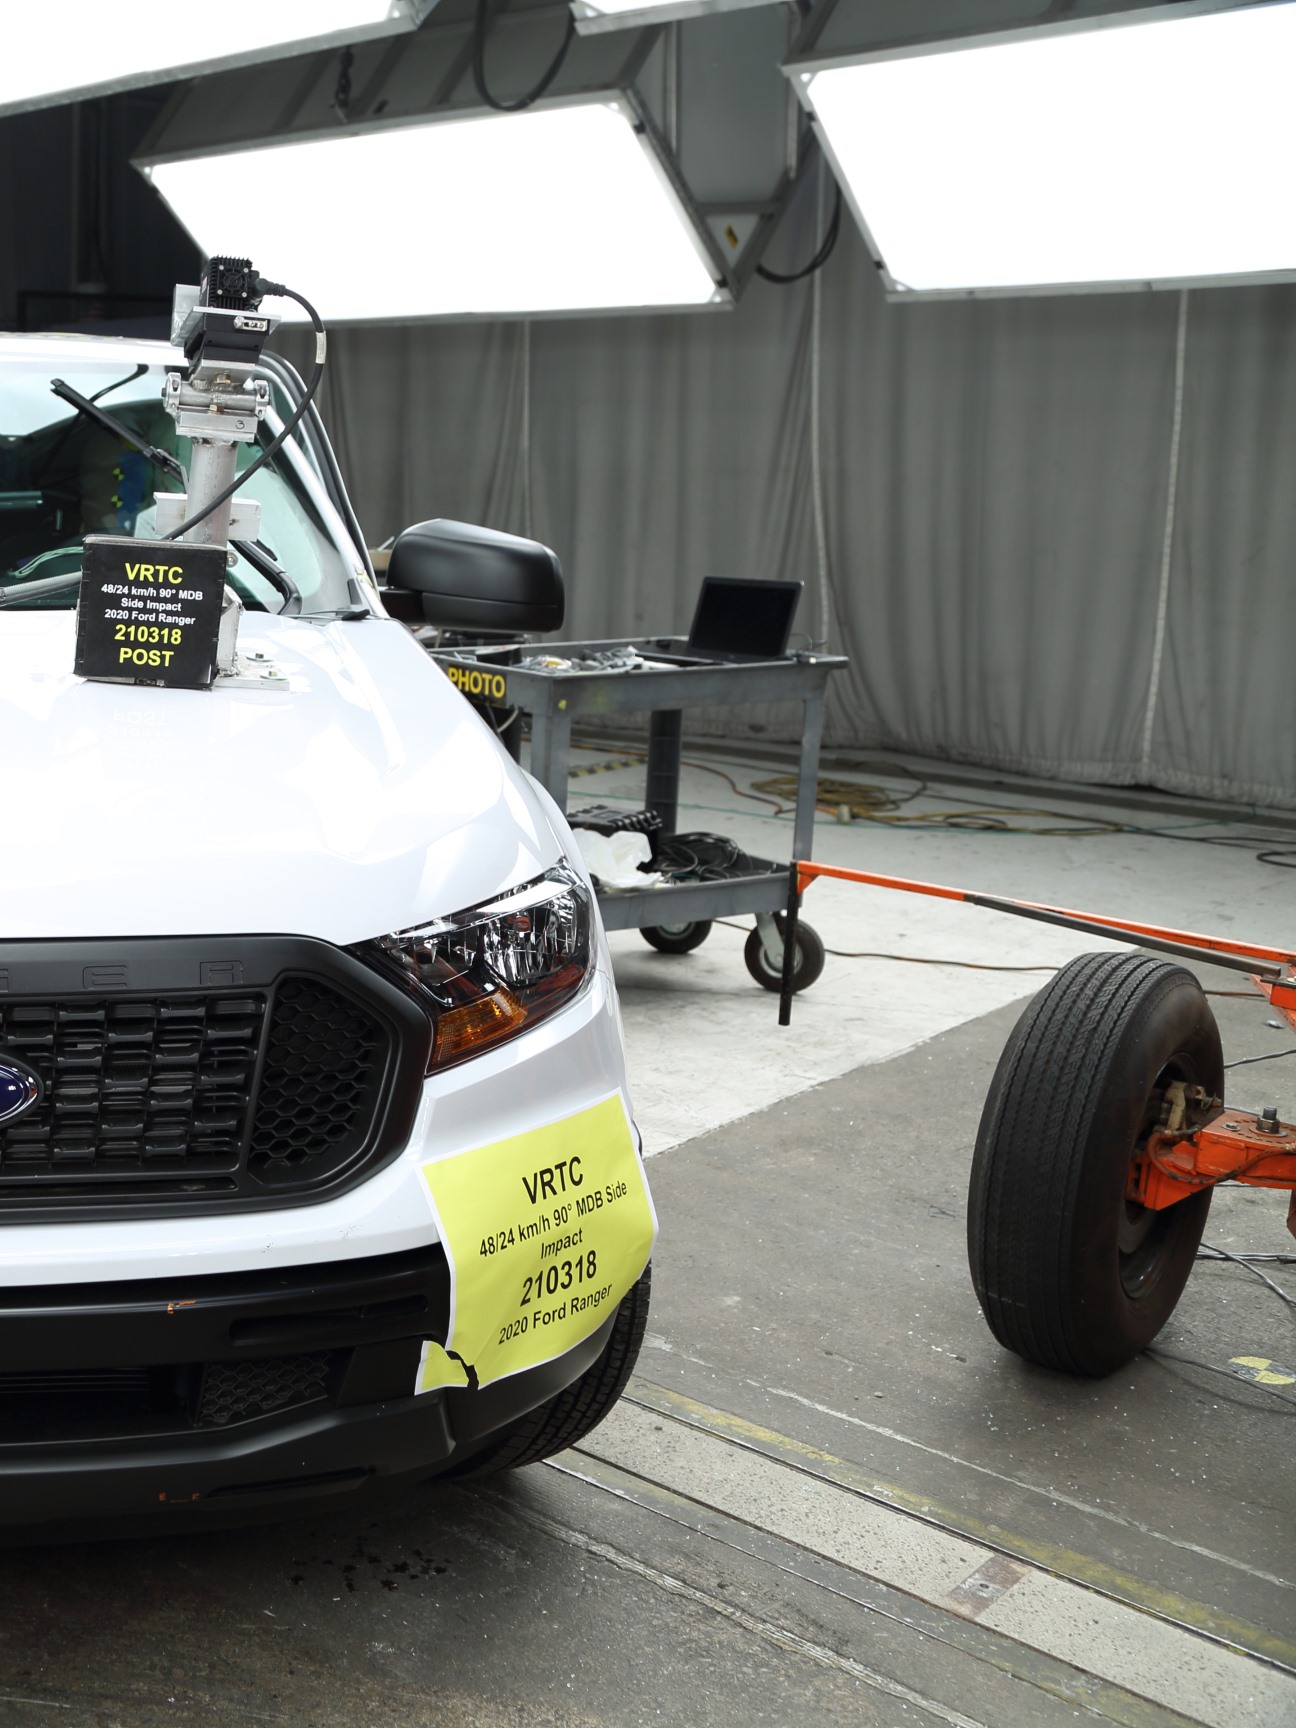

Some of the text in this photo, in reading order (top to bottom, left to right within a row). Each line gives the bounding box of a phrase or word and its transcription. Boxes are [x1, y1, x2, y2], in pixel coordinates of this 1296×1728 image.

[235, 419, 245, 430] 3
[125, 563, 183, 584] VRTC
[101, 584, 203, 600] 48/24 km/h 90° MDB
[121, 598, 182, 612] Side Impact
[104, 609, 196, 626] 2020 Ford Ranger
[114, 624, 182, 645] 210318
[118, 648, 174, 667] POST
[448, 667, 506, 698] PHOTO
[522, 1156, 584, 1205] VRTC
[479, 1180, 628, 1258] 48/24 km/h 90° MDB Side
[540, 1228, 584, 1259] Impact
[520, 1250, 597, 1307] 210318
[498, 1283, 613, 1345] 2020 Ford Ranger
